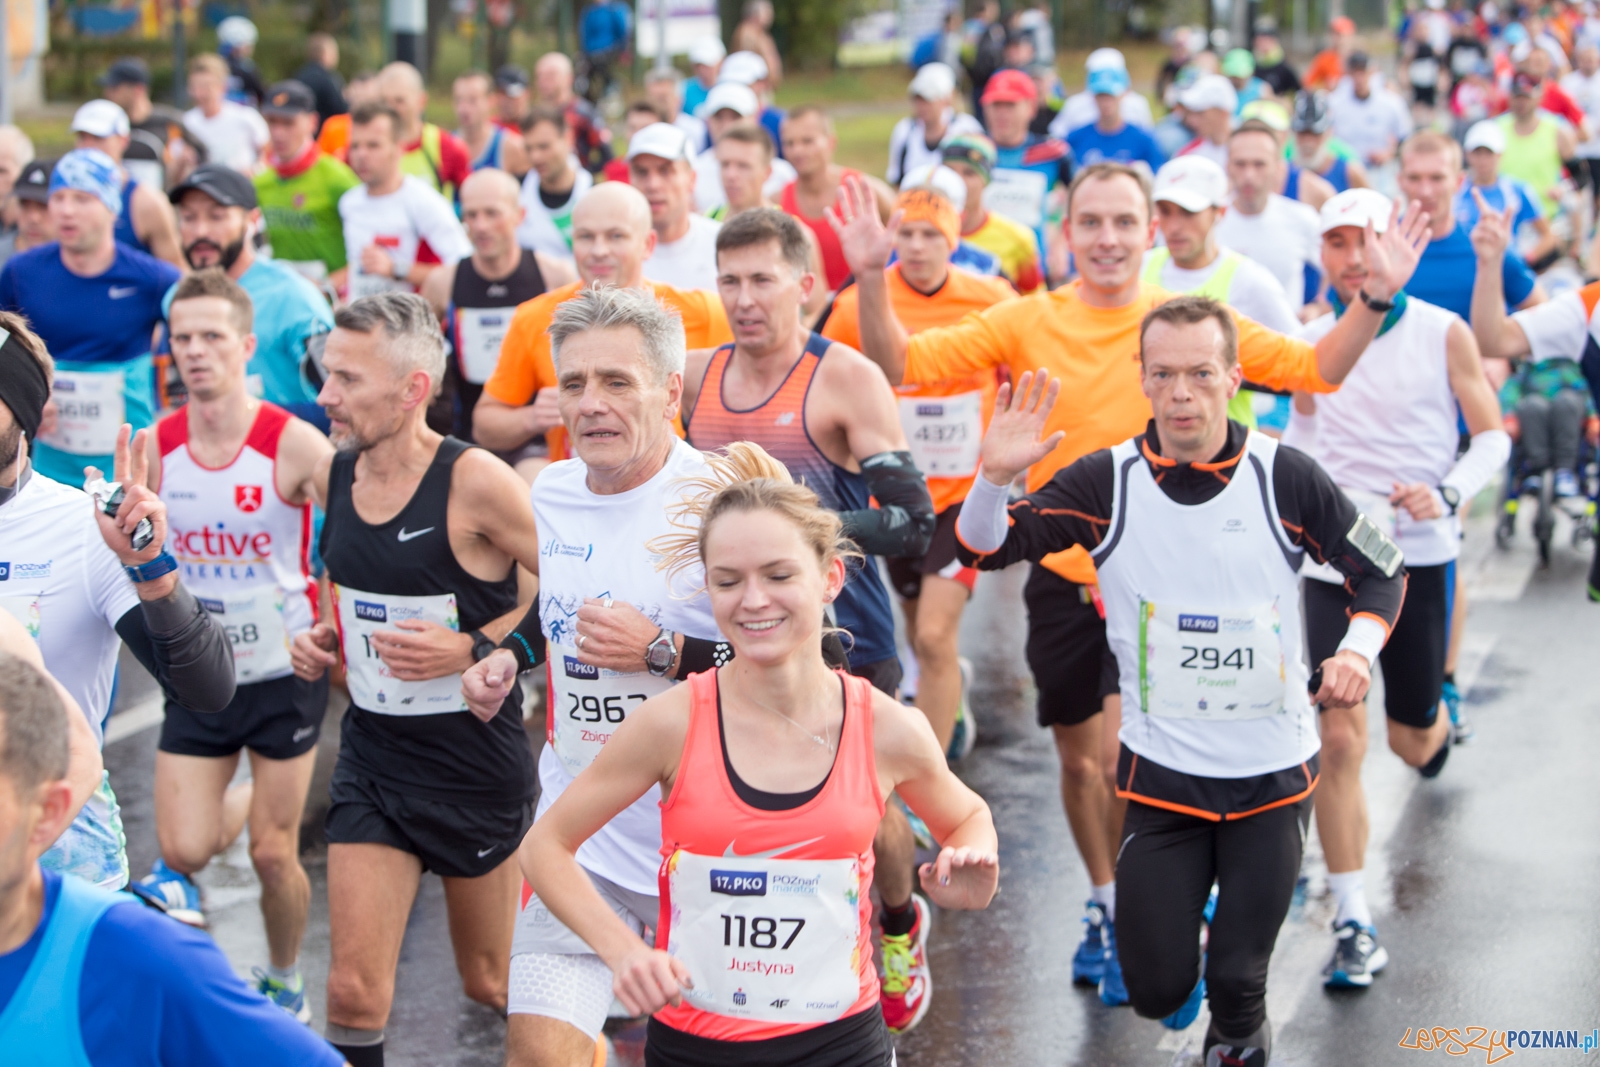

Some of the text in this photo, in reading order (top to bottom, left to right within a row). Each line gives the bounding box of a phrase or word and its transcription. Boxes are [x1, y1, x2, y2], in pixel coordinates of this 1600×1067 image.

[172, 522, 272, 557] active
[1180, 646, 1254, 670] 2941
[772, 883, 818, 896] maraton
[720, 914, 806, 950] 1187
[727, 957, 795, 976] Justyna
